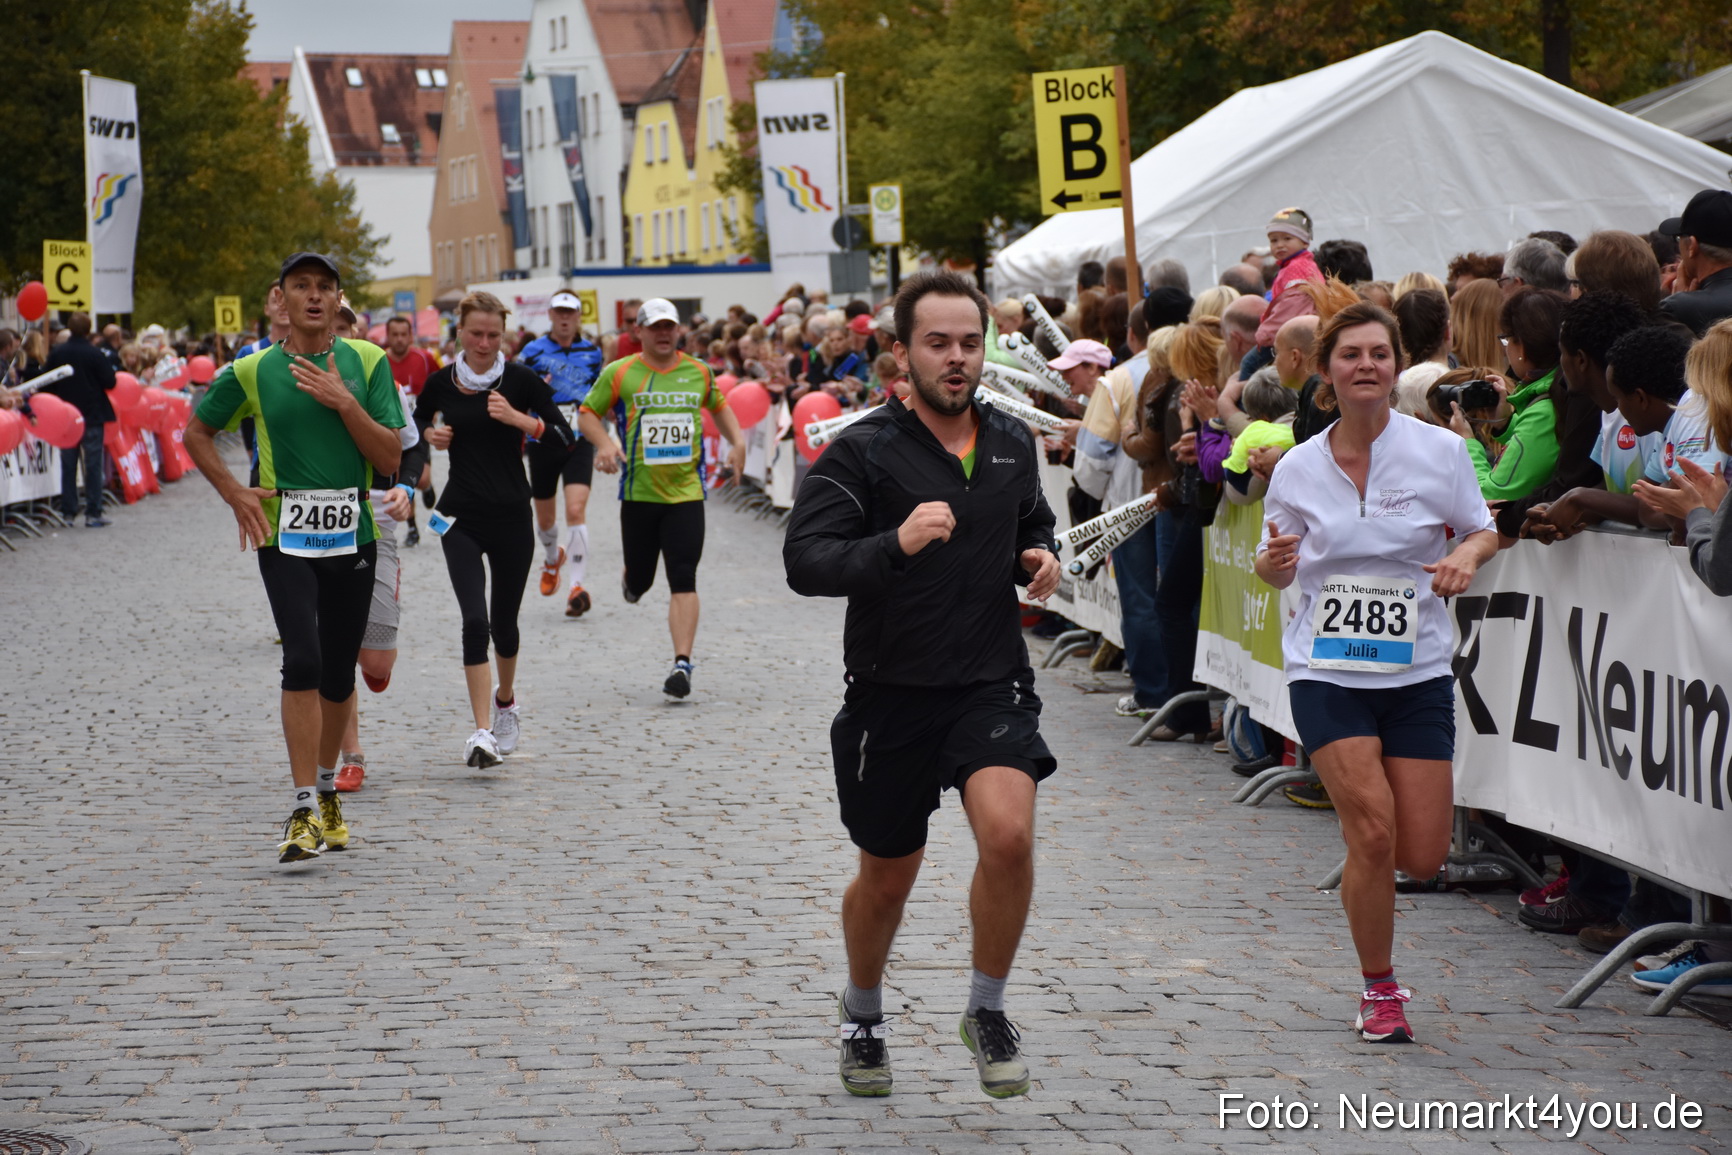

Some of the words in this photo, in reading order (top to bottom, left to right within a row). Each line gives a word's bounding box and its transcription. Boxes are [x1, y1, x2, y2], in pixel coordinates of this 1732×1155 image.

[1044, 74, 1115, 103] Block
[89, 115, 136, 140] swn
[1060, 112, 1107, 181] B
[48, 243, 86, 258] Block
[55, 262, 79, 295] C
[221, 307, 235, 326] D
[633, 391, 700, 409] BOCK
[648, 426, 690, 445] 2794
[310, 494, 346, 502] Neumarkt
[288, 504, 353, 531] 2468
[304, 536, 336, 548] Albert
[1068, 520, 1102, 544] BMW
[1087, 531, 1119, 562] BMW
[1351, 585, 1399, 598] Neumarkt
[1323, 598, 1408, 637] 2483
[1344, 642, 1378, 659] Julia
[1568, 606, 1732, 811] Neum
